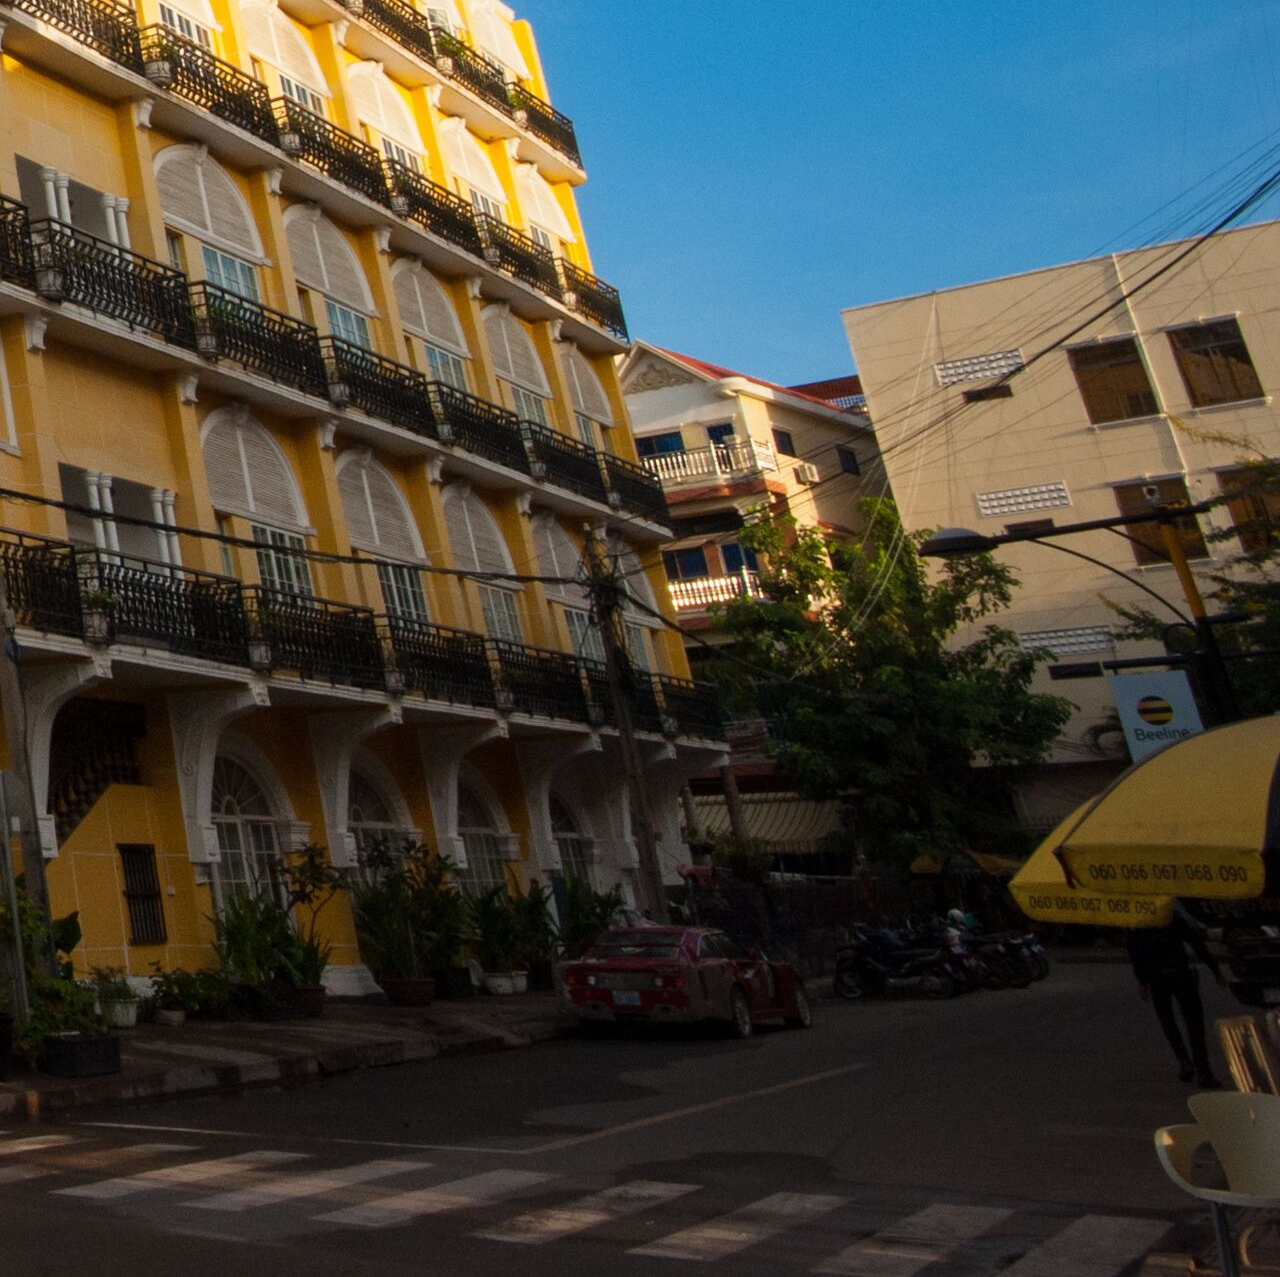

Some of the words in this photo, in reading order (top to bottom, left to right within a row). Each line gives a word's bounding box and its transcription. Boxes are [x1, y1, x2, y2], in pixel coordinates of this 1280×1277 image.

[1133, 727, 1191, 742] Beeline
[1089, 864, 1117, 880] 060
[1120, 864, 1148, 881] 066
[1151, 864, 1178, 881] 067
[1185, 864, 1213, 882] 068
[1219, 865, 1248, 882] 090
[1028, 895, 1052, 910] 060
[1055, 896, 1078, 911] 066
[1081, 897, 1102, 911] 067
[1108, 899, 1129, 914] 068
[1134, 900, 1157, 915] 090
